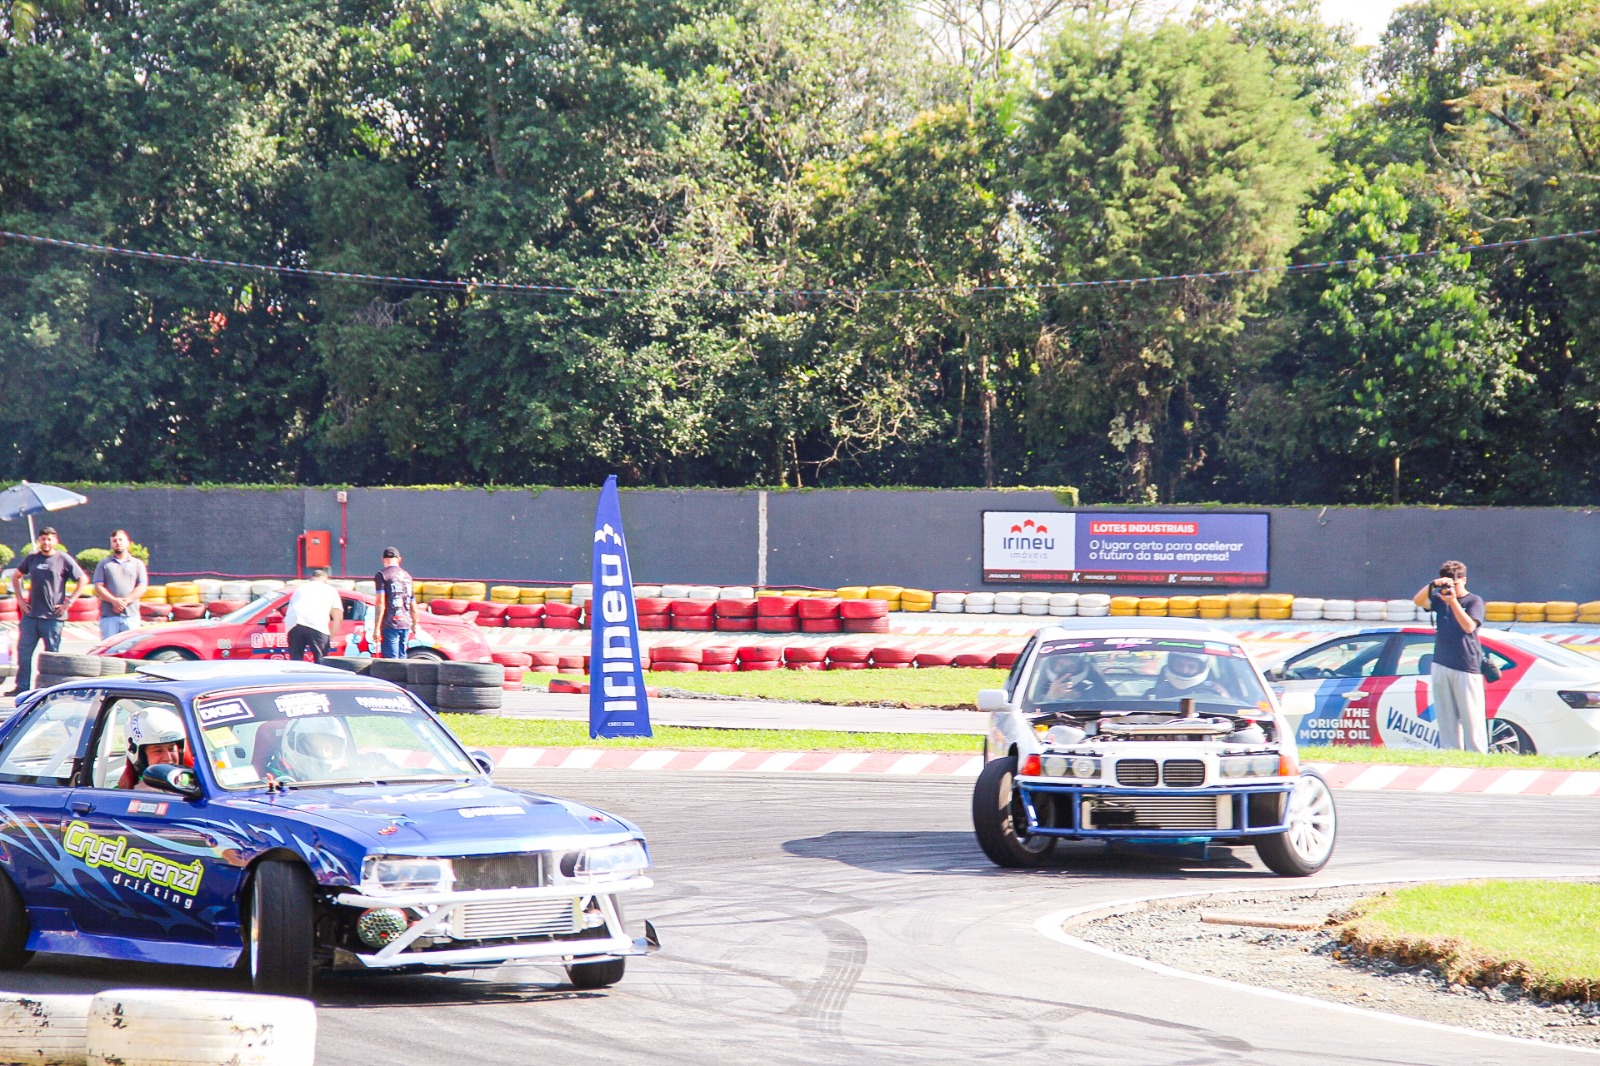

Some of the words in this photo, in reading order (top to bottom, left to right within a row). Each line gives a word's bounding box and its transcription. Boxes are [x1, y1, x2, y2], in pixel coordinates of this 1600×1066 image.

[1093, 523, 1127, 533] LOTES
[1128, 524, 1194, 534] INDUSTRIAIS
[1003, 537, 1055, 550] irineu
[1089, 540, 1100, 550] O
[1102, 540, 1131, 553] lugar
[1133, 541, 1163, 551] certo
[1165, 542, 1193, 552] para
[1194, 541, 1243, 551] acelerar
[1089, 552, 1097, 560] o
[1099, 550, 1134, 561] futuro
[1136, 551, 1151, 561] da
[1153, 552, 1174, 561] sua
[1176, 551, 1229, 563] empresa!
[601, 554, 638, 712] irineu
[1345, 708, 1370, 717] THE
[1308, 718, 1370, 729] ORIGINAL
[1386, 706, 1441, 750] VALVOLIN
[1300, 729, 1345, 740] MOTOR
[1348, 729, 1370, 740] OIL
[112, 873, 193, 910] drifting
